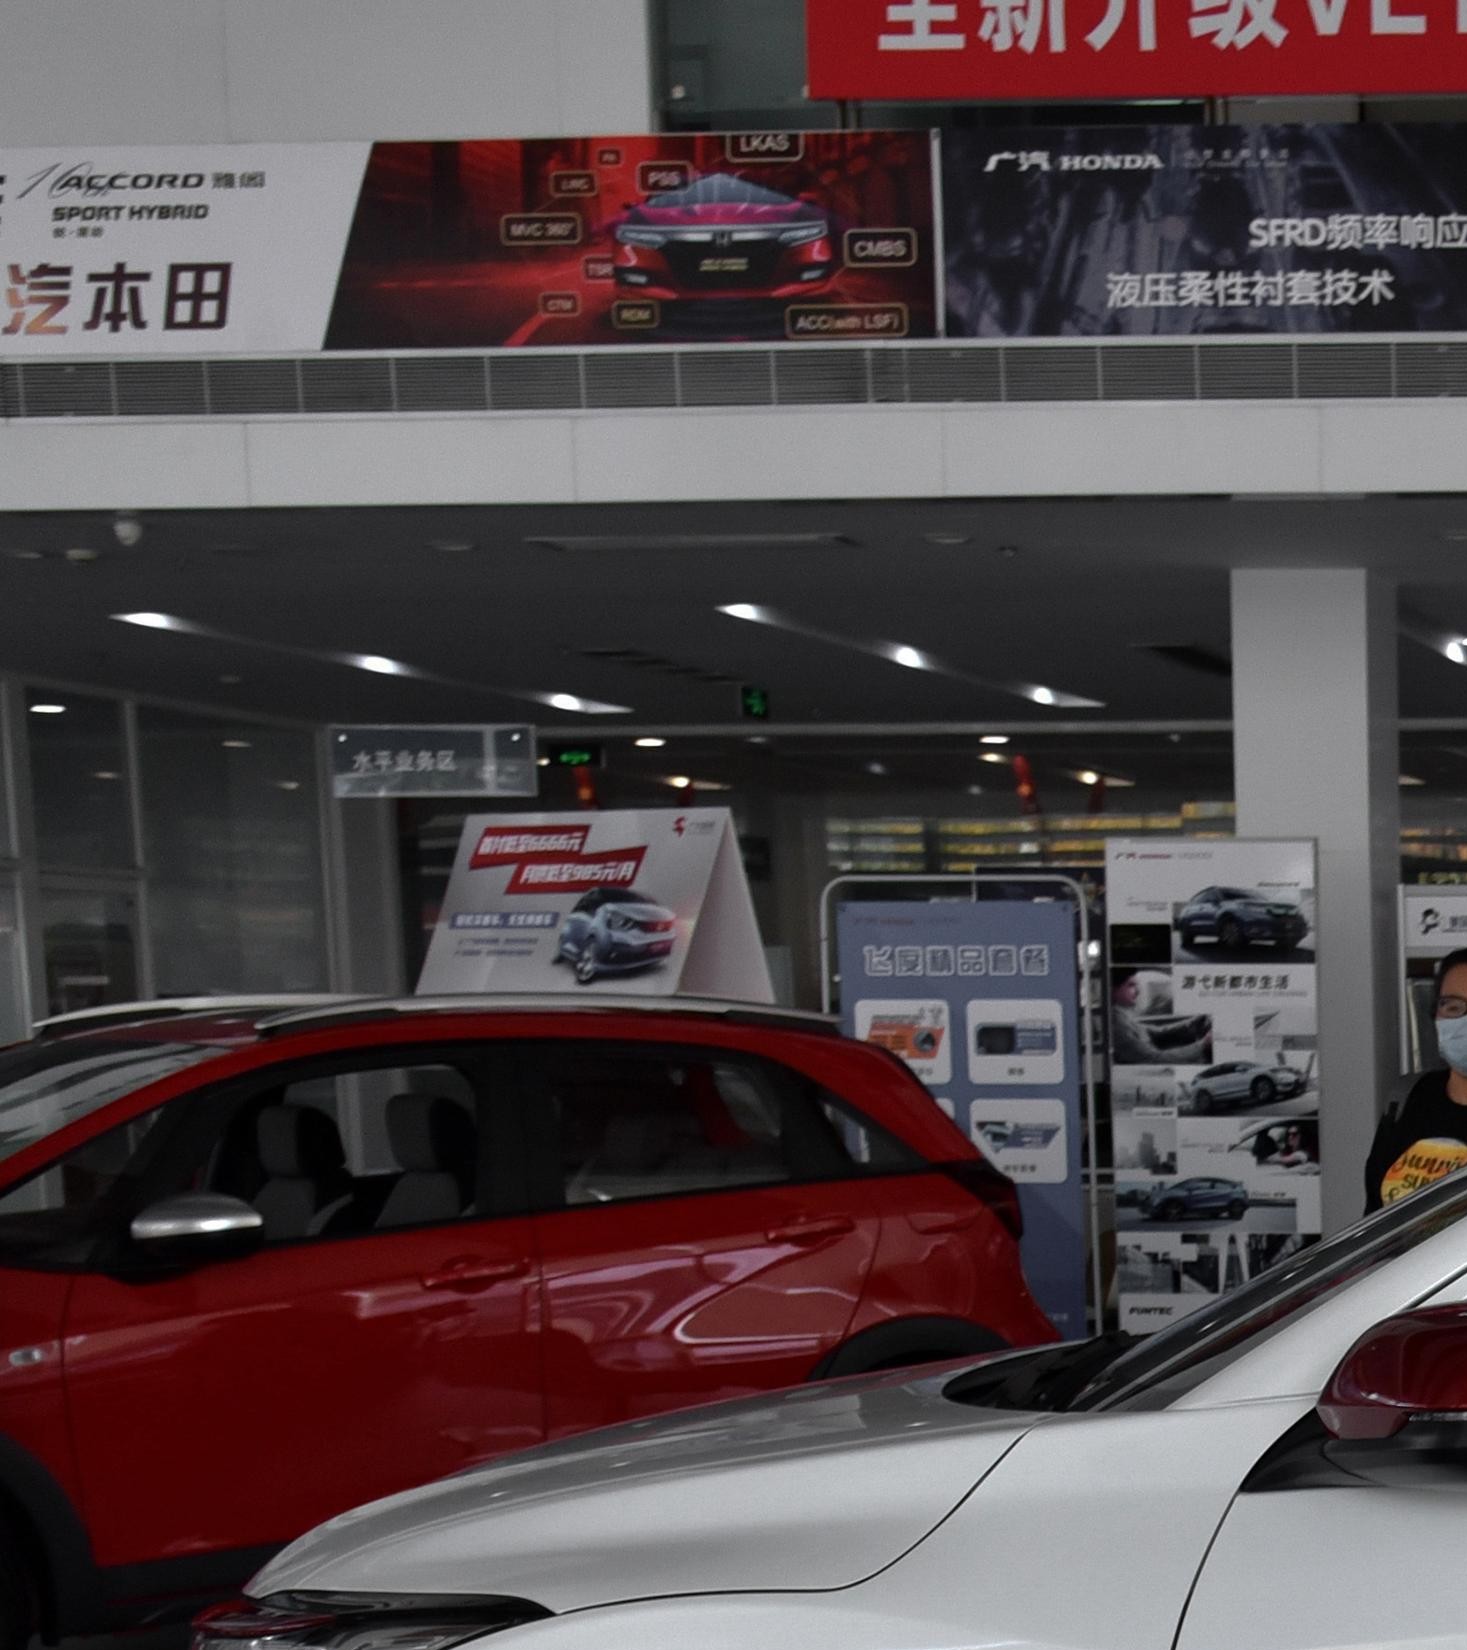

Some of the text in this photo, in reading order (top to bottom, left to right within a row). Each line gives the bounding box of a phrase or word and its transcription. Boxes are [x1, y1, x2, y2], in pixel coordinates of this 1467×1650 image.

[739, 134, 789, 151] LKAS
[984, 151, 1051, 172] 广汽
[1059, 154, 1164, 171] HONDA
[59, 173, 206, 190] ACCORD
[52, 204, 209, 222] SPORT HYBRID
[1106, 269, 1395, 308] 液压柔性衬套技术
[2, 262, 233, 335] 汽本田
[1129, 1306, 1173, 1316] FUNTEC
